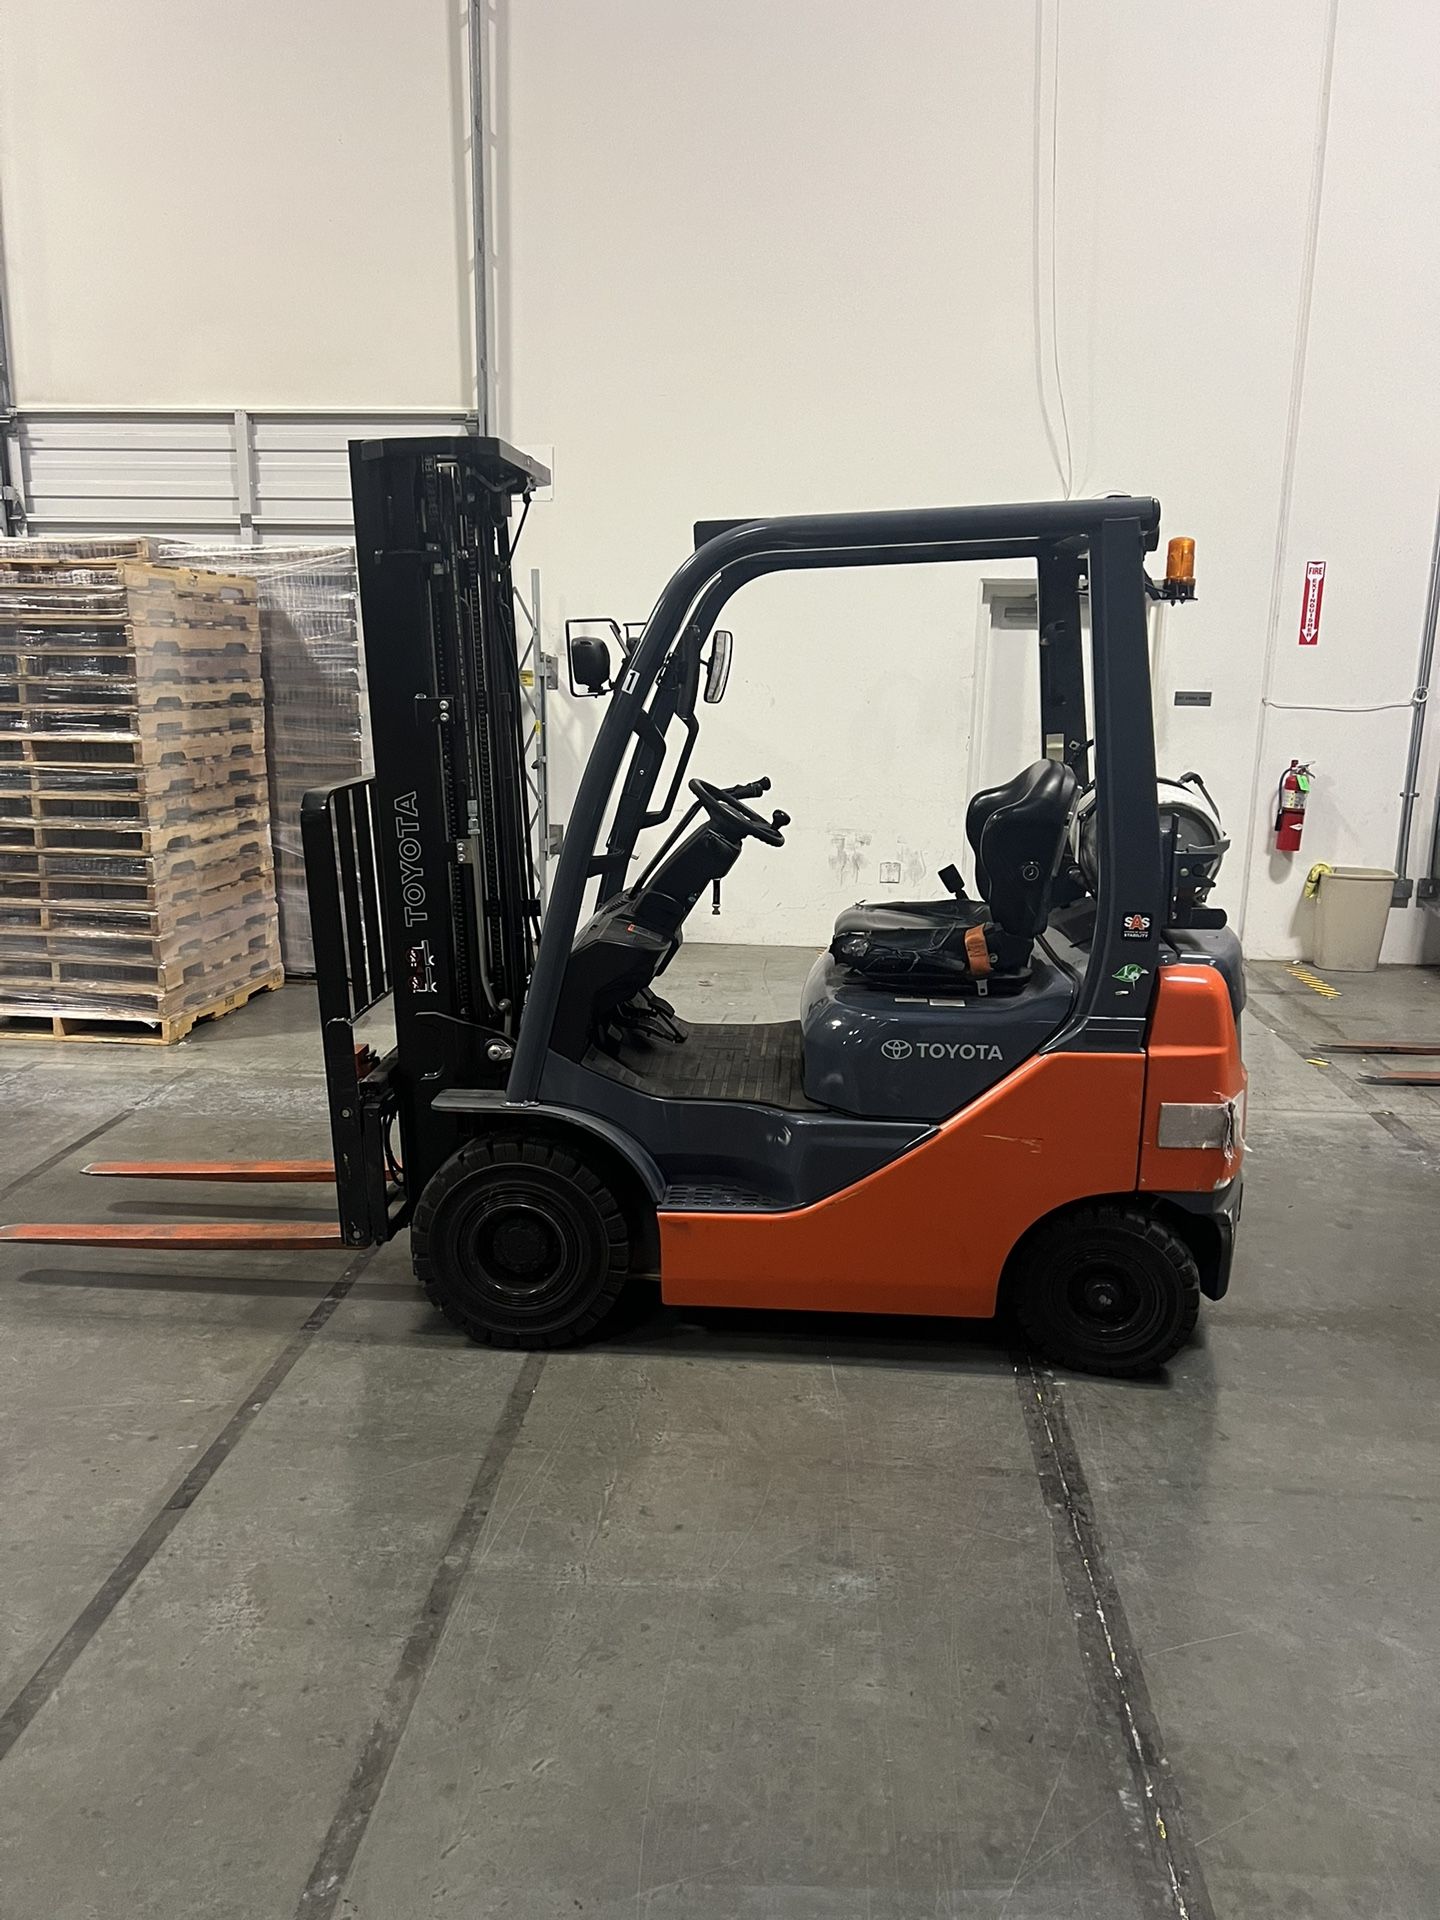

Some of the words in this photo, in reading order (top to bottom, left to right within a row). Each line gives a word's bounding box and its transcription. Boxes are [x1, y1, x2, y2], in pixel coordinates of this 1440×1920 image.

[1308, 567, 1323, 575] FIRE
[1306, 578, 1318, 637] EXTINGUISHER
[625, 672, 637, 692] 1
[394, 791, 428, 927] TOYOTA
[1123, 914, 1150, 930] SAS
[916, 1043, 1003, 1061] TOYOTA
